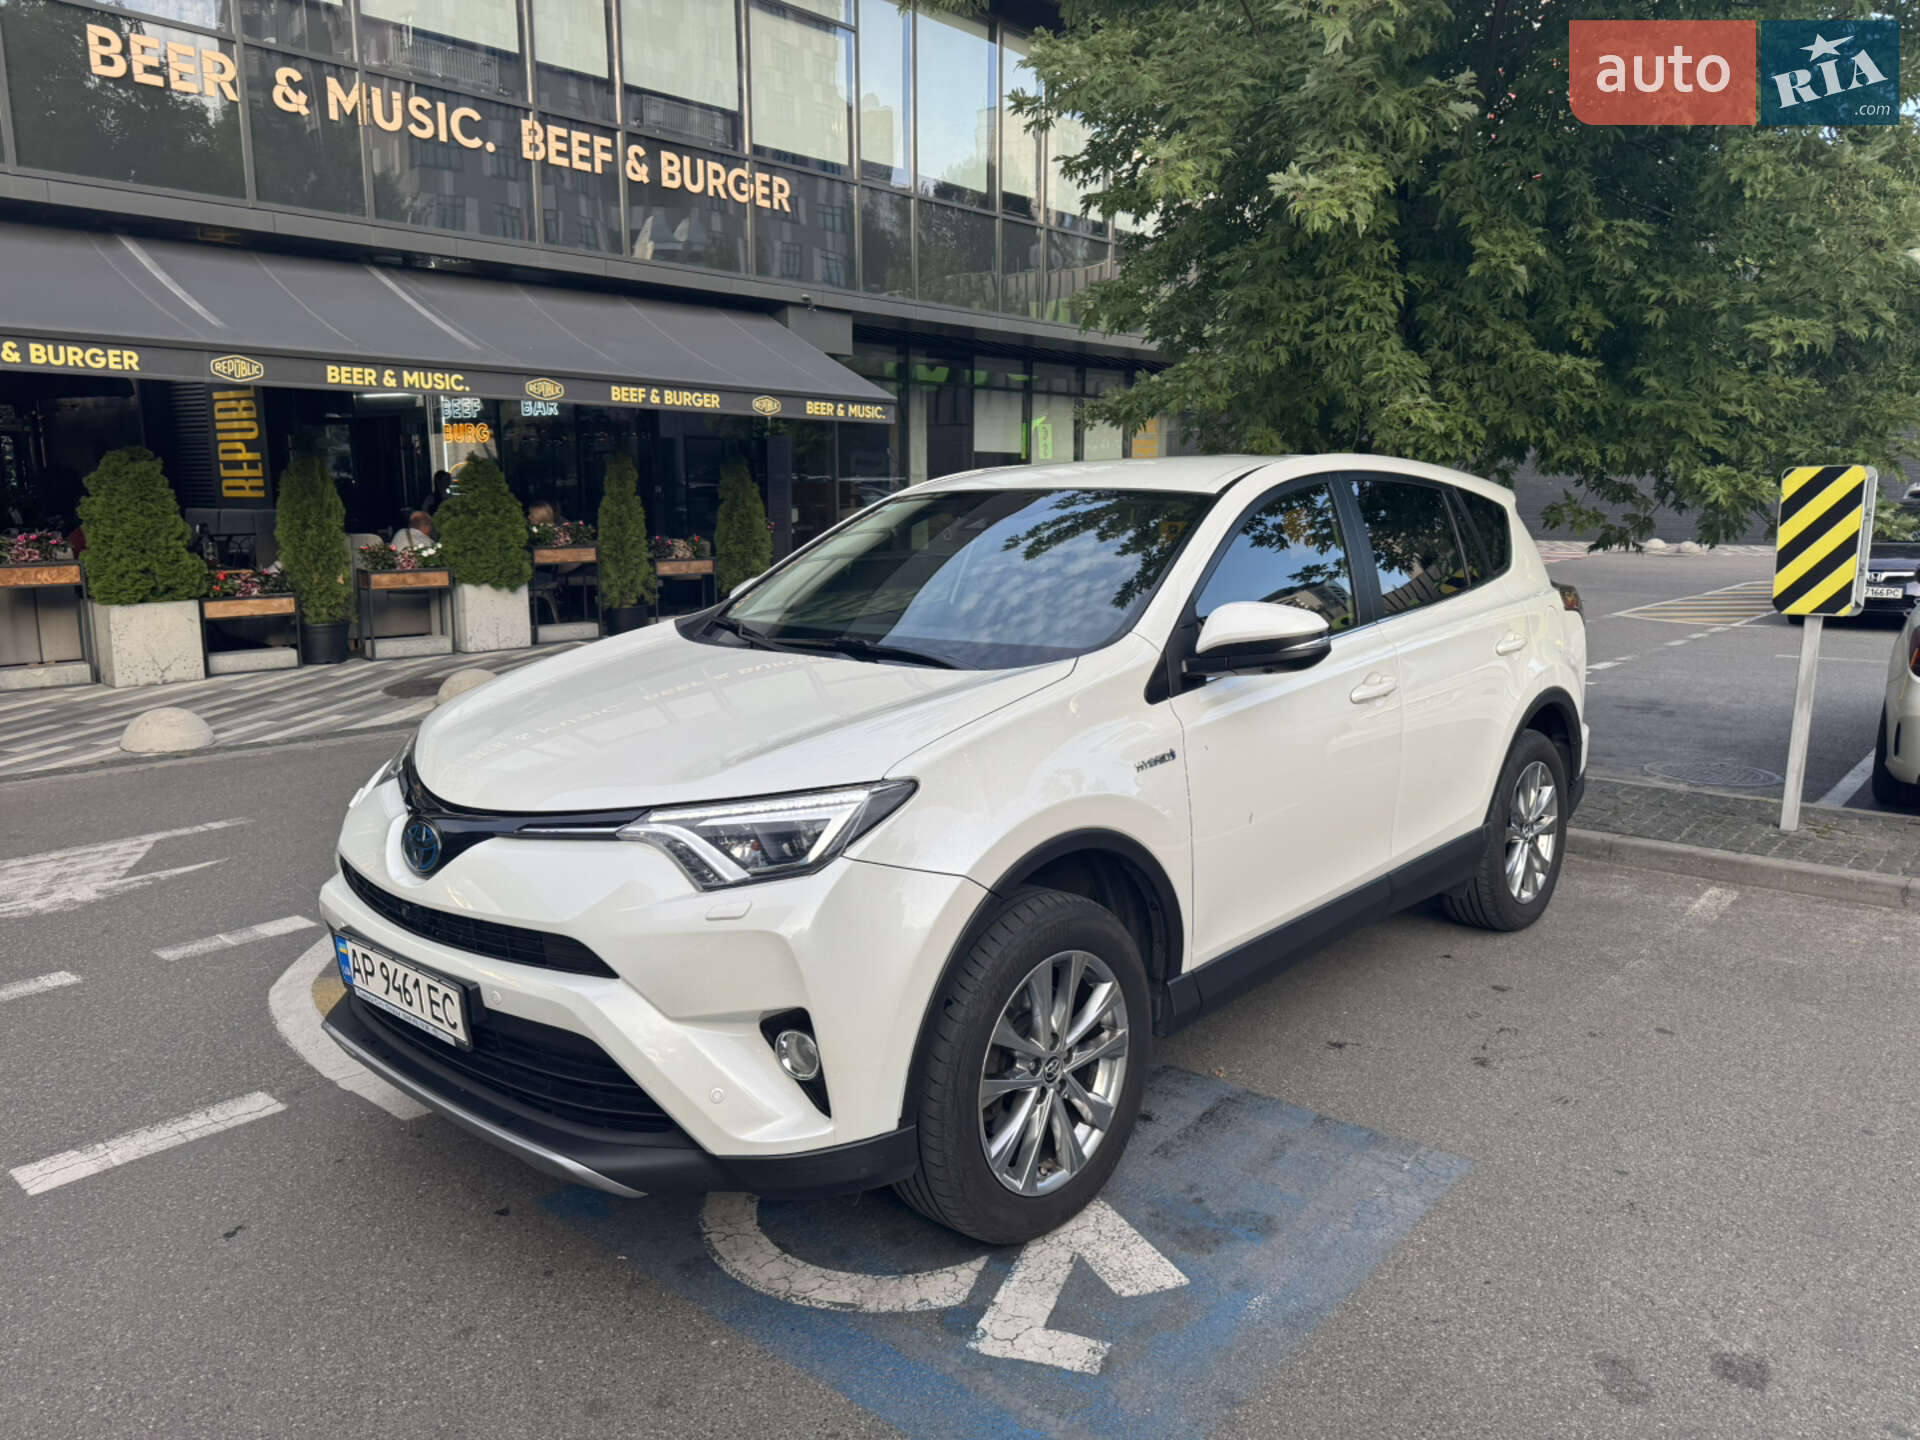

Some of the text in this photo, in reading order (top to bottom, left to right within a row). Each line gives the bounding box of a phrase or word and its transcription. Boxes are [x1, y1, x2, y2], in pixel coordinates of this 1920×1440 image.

[86, 23, 496, 153] BEER & MUSIC.
[520, 118, 791, 213] BEEF & BURGER
[1, 340, 140, 371] & BURGER
[214, 359, 260, 379] REPUBLIC
[326, 365, 470, 392] BEER & MUSIC.
[520, 400, 560, 417] BAR
[610, 385, 720, 409] BEEF & BURGER
[806, 400, 886, 419] BEER & MUSIC.
[351, 948, 376, 986] AP
[380, 961, 425, 1014] 9461
[427, 983, 458, 1030] EC
